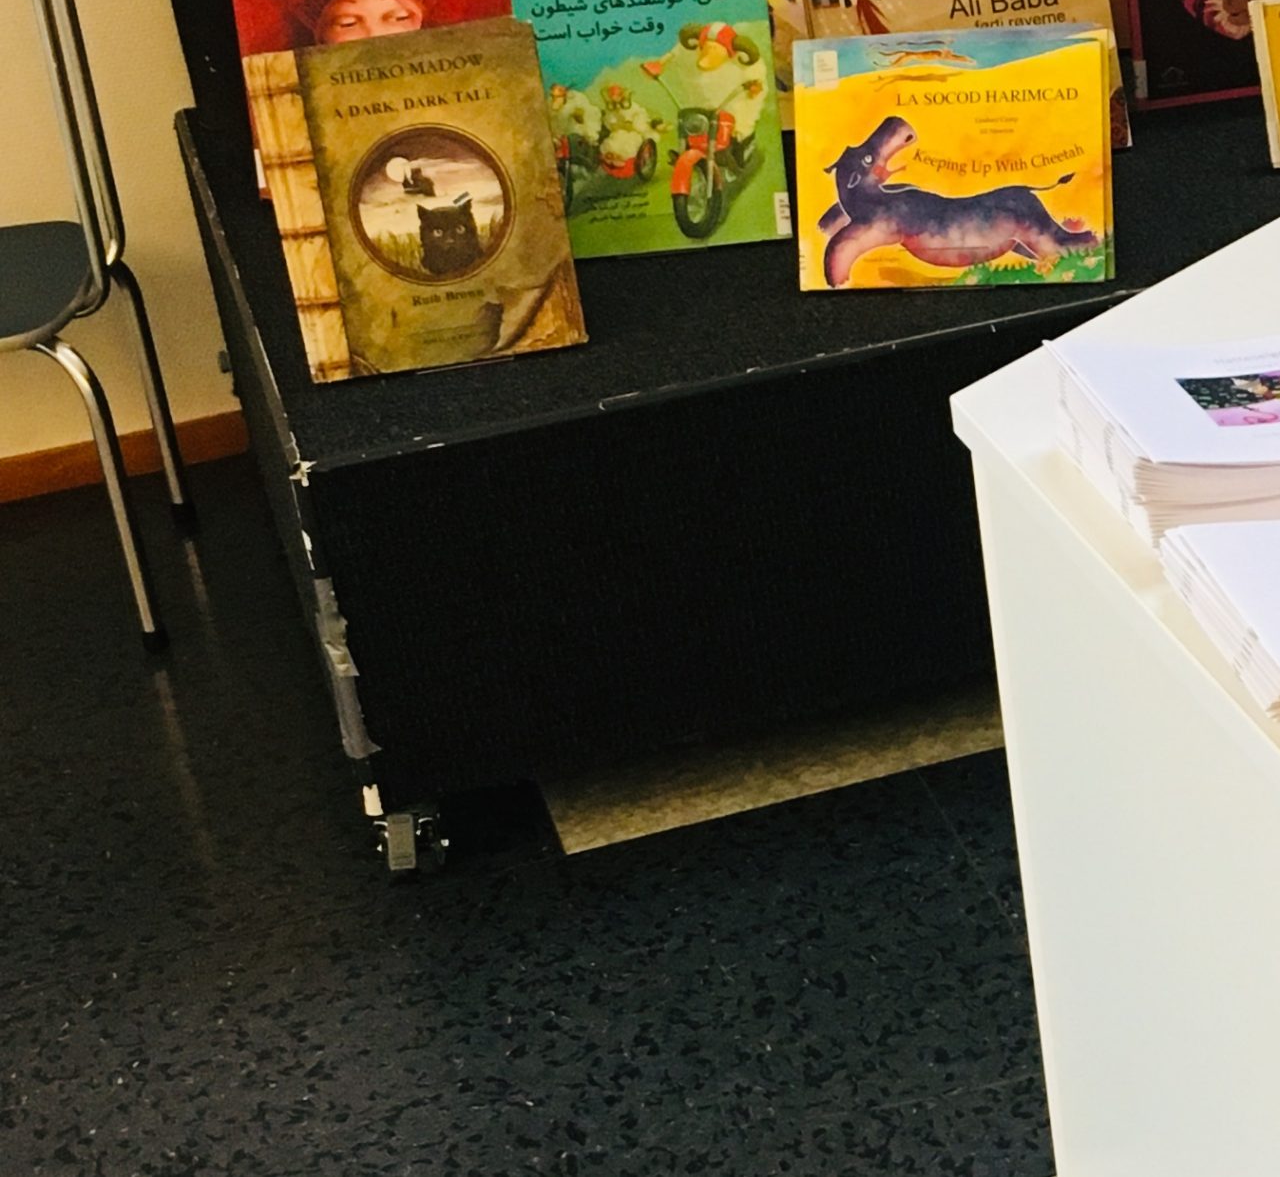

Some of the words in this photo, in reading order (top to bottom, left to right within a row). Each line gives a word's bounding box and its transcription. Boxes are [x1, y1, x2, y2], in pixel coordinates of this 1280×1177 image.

[330, 64, 404, 87] SHEEKO
[409, 52, 484, 76] MADOW
[403, 94, 449, 111] DARK
[454, 86, 496, 103] TALE
[896, 93, 919, 107] LA
[923, 90, 982, 106] SOCOD
[985, 87, 1079, 104] HARIMCAD
[912, 148, 968, 174] Keeping
[971, 159, 992, 177] Up
[996, 157, 1029, 173] With
[1030, 143, 1086, 169] Cheetah
